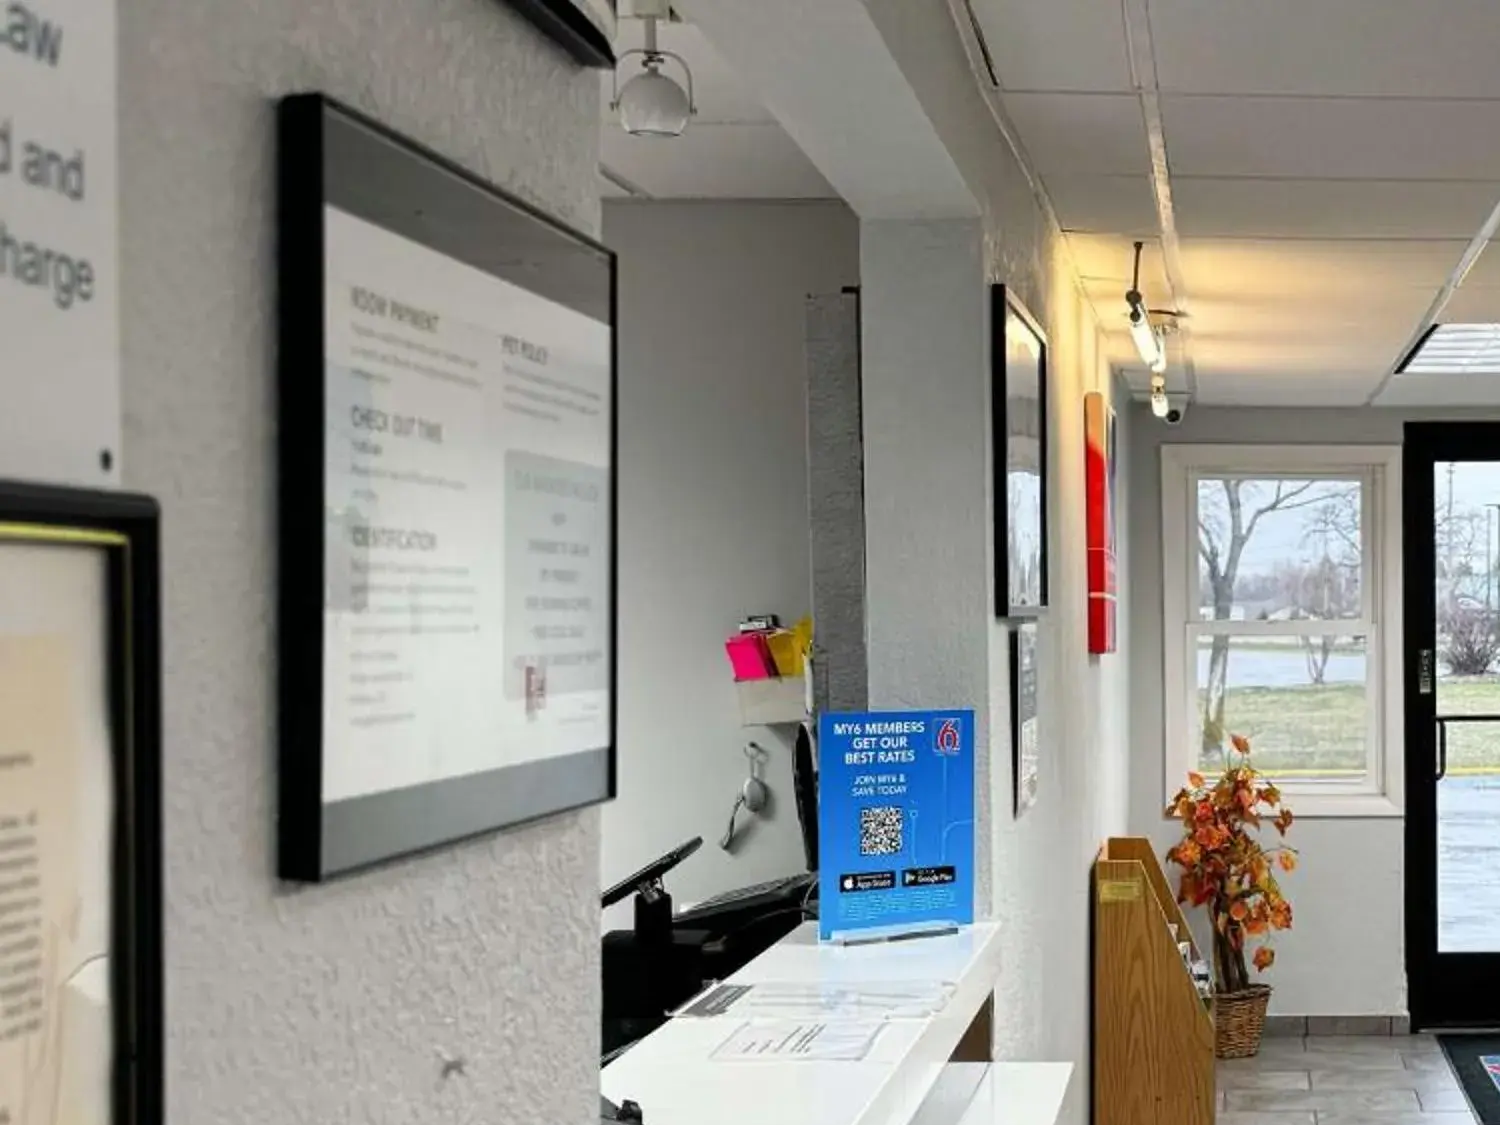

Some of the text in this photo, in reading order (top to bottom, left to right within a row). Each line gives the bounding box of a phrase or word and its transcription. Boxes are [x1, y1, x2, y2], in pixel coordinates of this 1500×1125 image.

[21, 140, 85, 201] and
[833, 721, 925, 735] MY6 MEMBERS
[853, 736, 908, 749] GET OUR
[845, 749, 915, 765] BEST RATES
